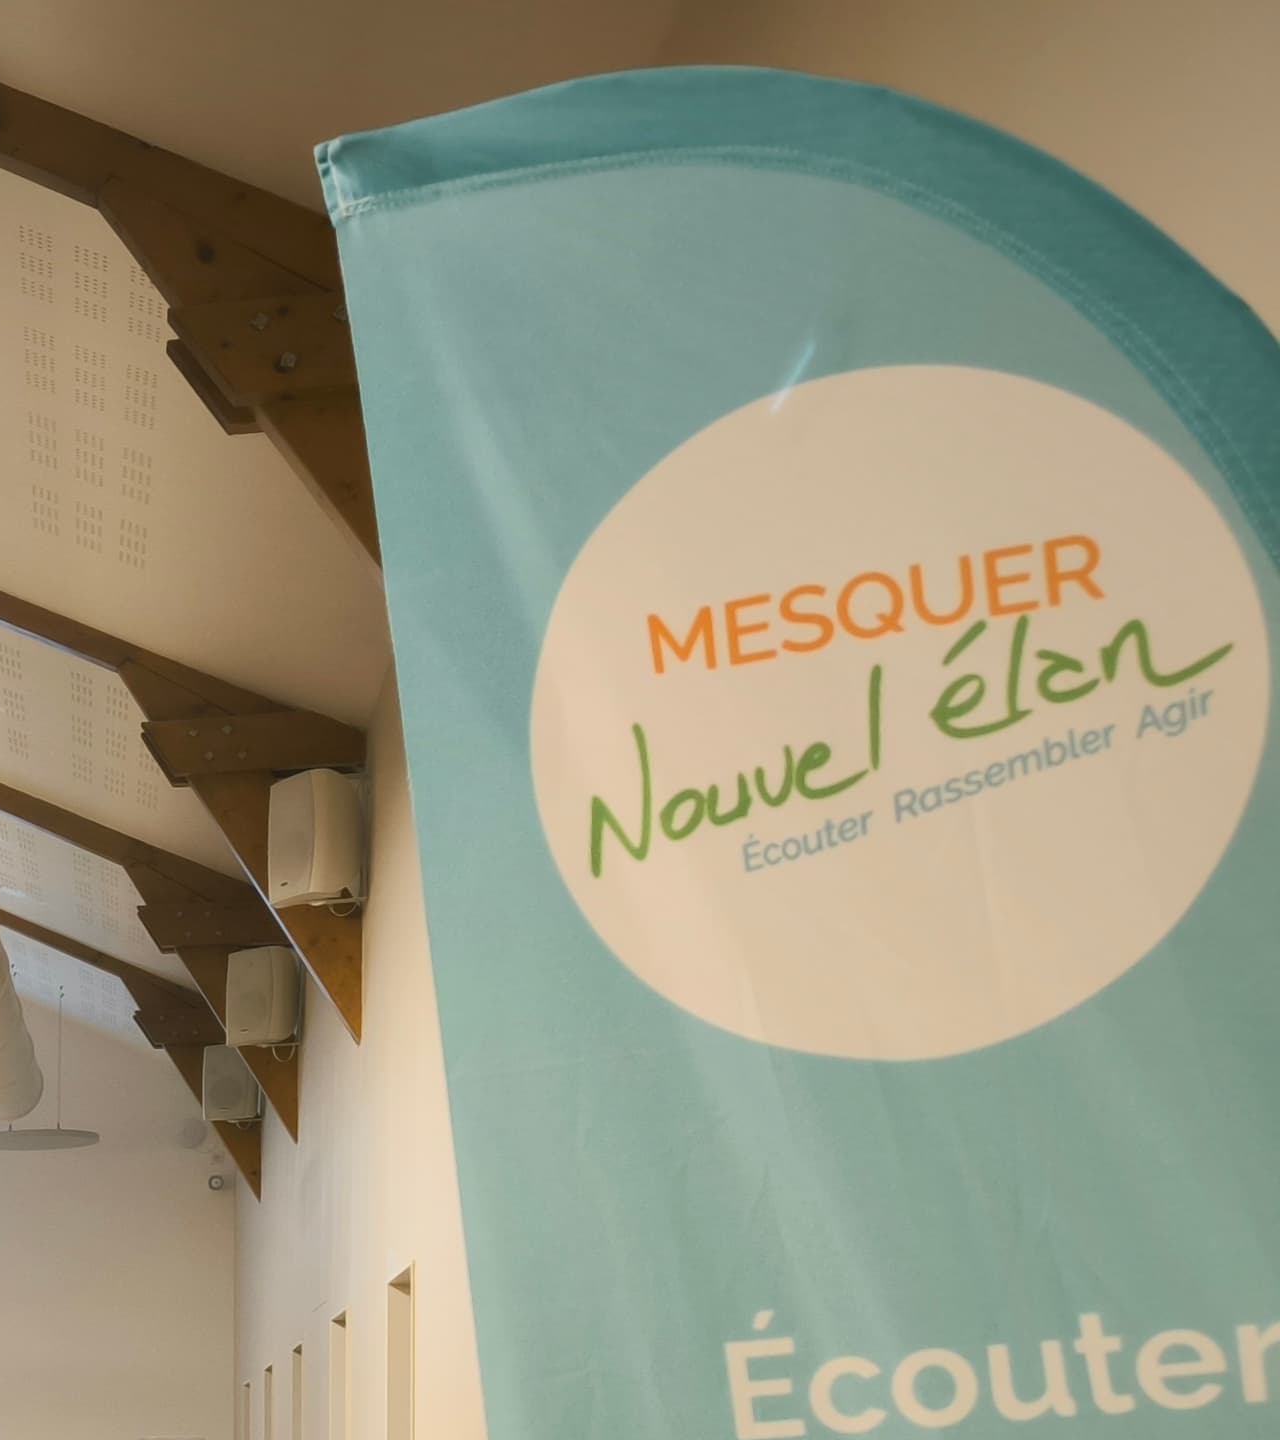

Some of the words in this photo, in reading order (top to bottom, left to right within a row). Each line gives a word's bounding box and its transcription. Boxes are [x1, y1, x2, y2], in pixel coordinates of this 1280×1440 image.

[646, 534, 1105, 675] MESQUER
[589, 663, 883, 879] Nouvel
[928, 613, 1235, 740] élan
[741, 810, 873, 873] Écouter
[891, 723, 1117, 824] Rassembler
[1134, 686, 1215, 740] Agir
